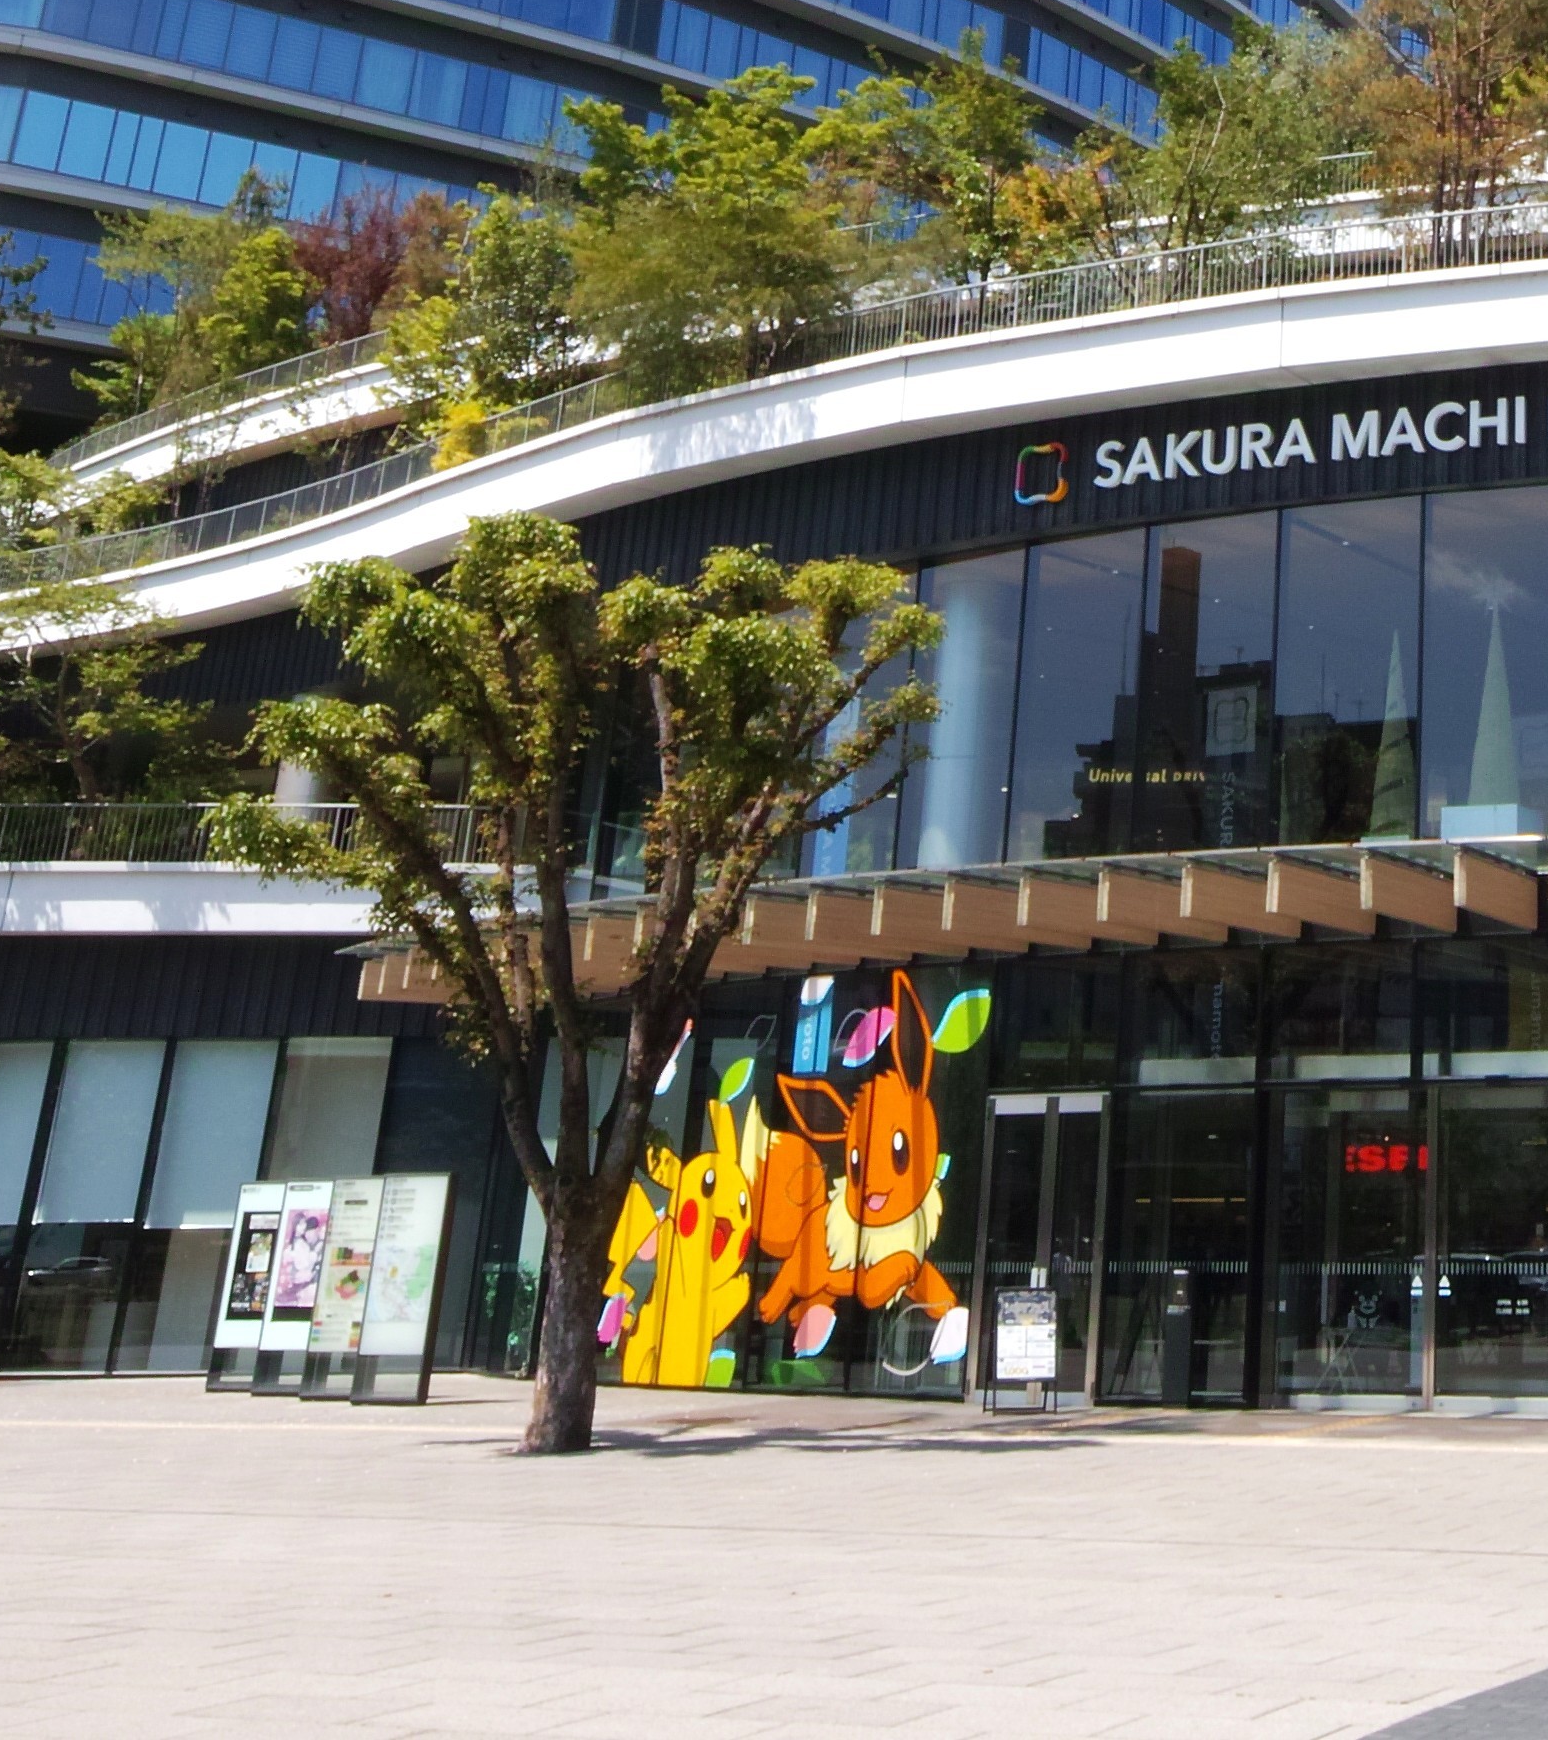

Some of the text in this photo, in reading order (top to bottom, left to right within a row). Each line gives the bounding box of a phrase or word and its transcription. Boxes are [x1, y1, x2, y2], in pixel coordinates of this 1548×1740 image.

[1092, 417, 1316, 489] SAKURA
[1330, 395, 1527, 461] MACHI
[1088, 767, 1167, 784] Univeal
